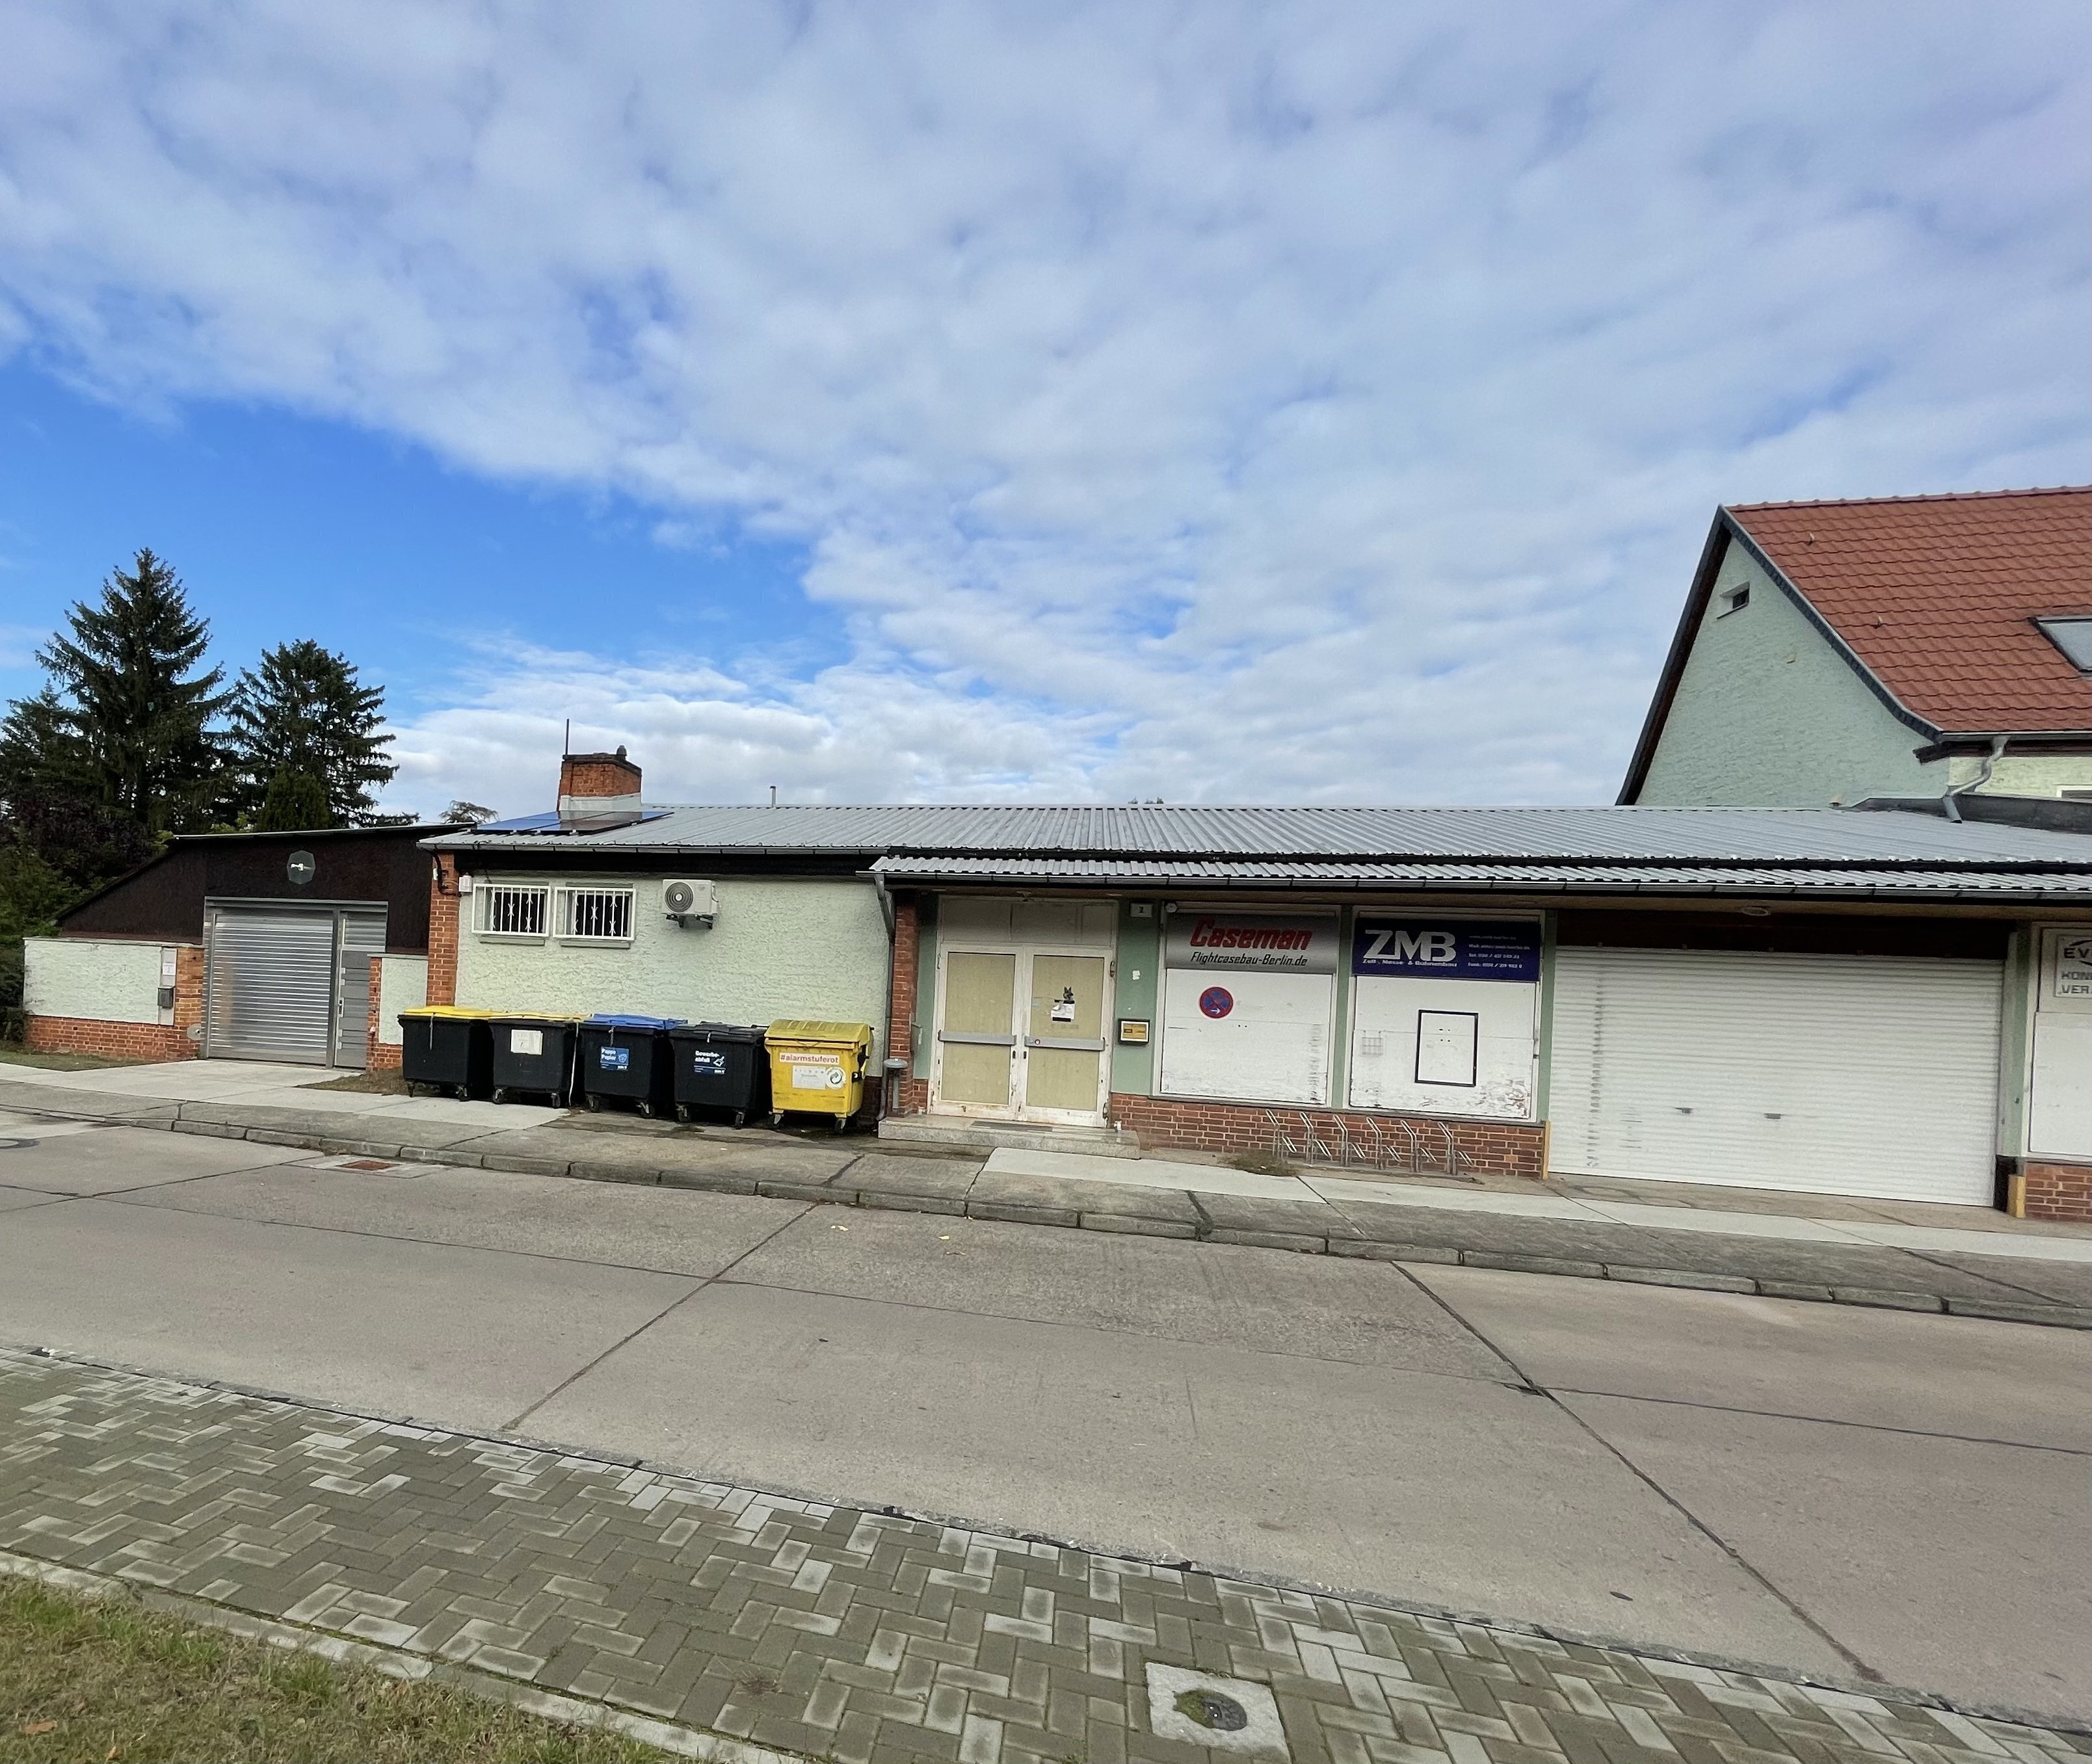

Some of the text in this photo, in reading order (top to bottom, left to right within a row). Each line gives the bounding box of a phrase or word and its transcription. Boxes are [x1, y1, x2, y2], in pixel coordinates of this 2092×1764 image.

[1190, 915, 1313, 951] Caseman
[1363, 930, 1457, 962] ZMB
[1191, 951, 1308, 966] Flightcasebau-Berlin.de
[2061, 984, 2092, 994] VER
[780, 1055, 839, 1063] #alarmstuferot
